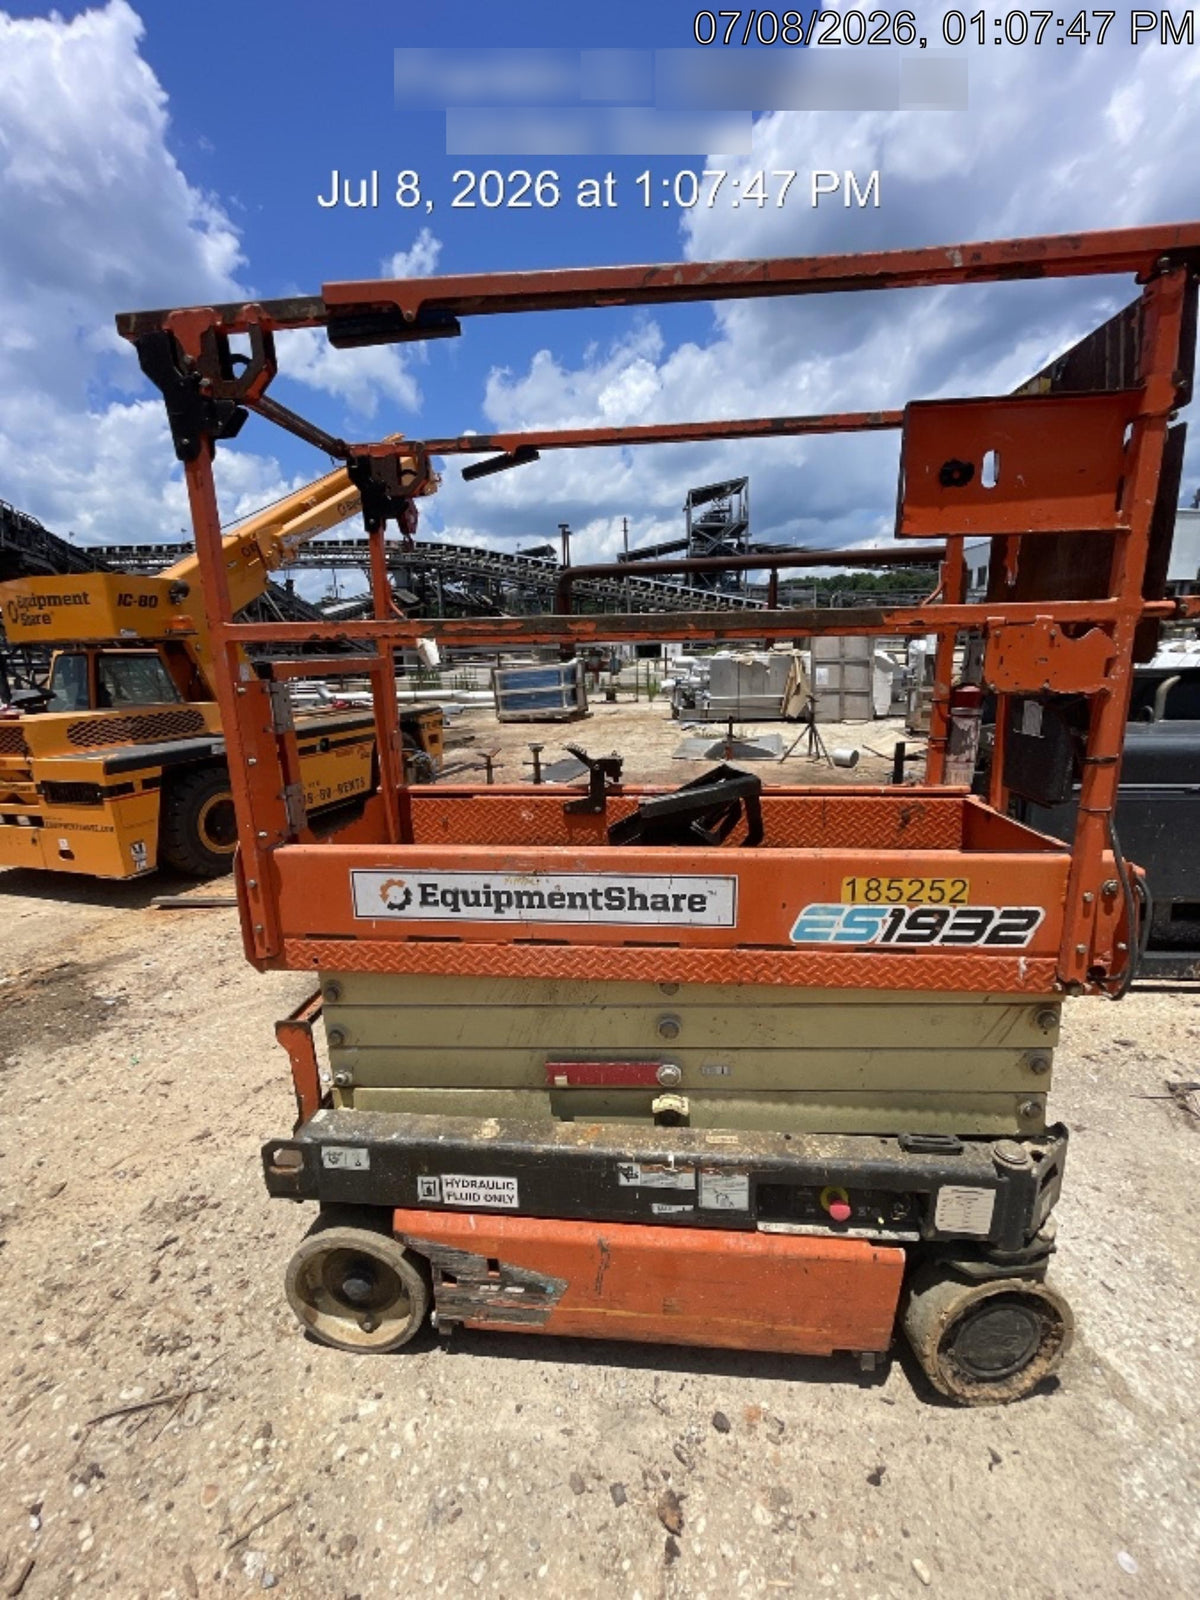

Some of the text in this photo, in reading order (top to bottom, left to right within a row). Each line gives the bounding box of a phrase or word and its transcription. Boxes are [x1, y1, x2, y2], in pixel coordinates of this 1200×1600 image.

[117, 592, 159, 609] IC-80
[417, 882, 708, 915] EquipmentShare
[844, 878, 969, 904] 185252
[791, 904, 1043, 947] ES1932
[445, 1177, 515, 1192] HYDRAULIC
[446, 1191, 515, 1205] FLUID ONLY
